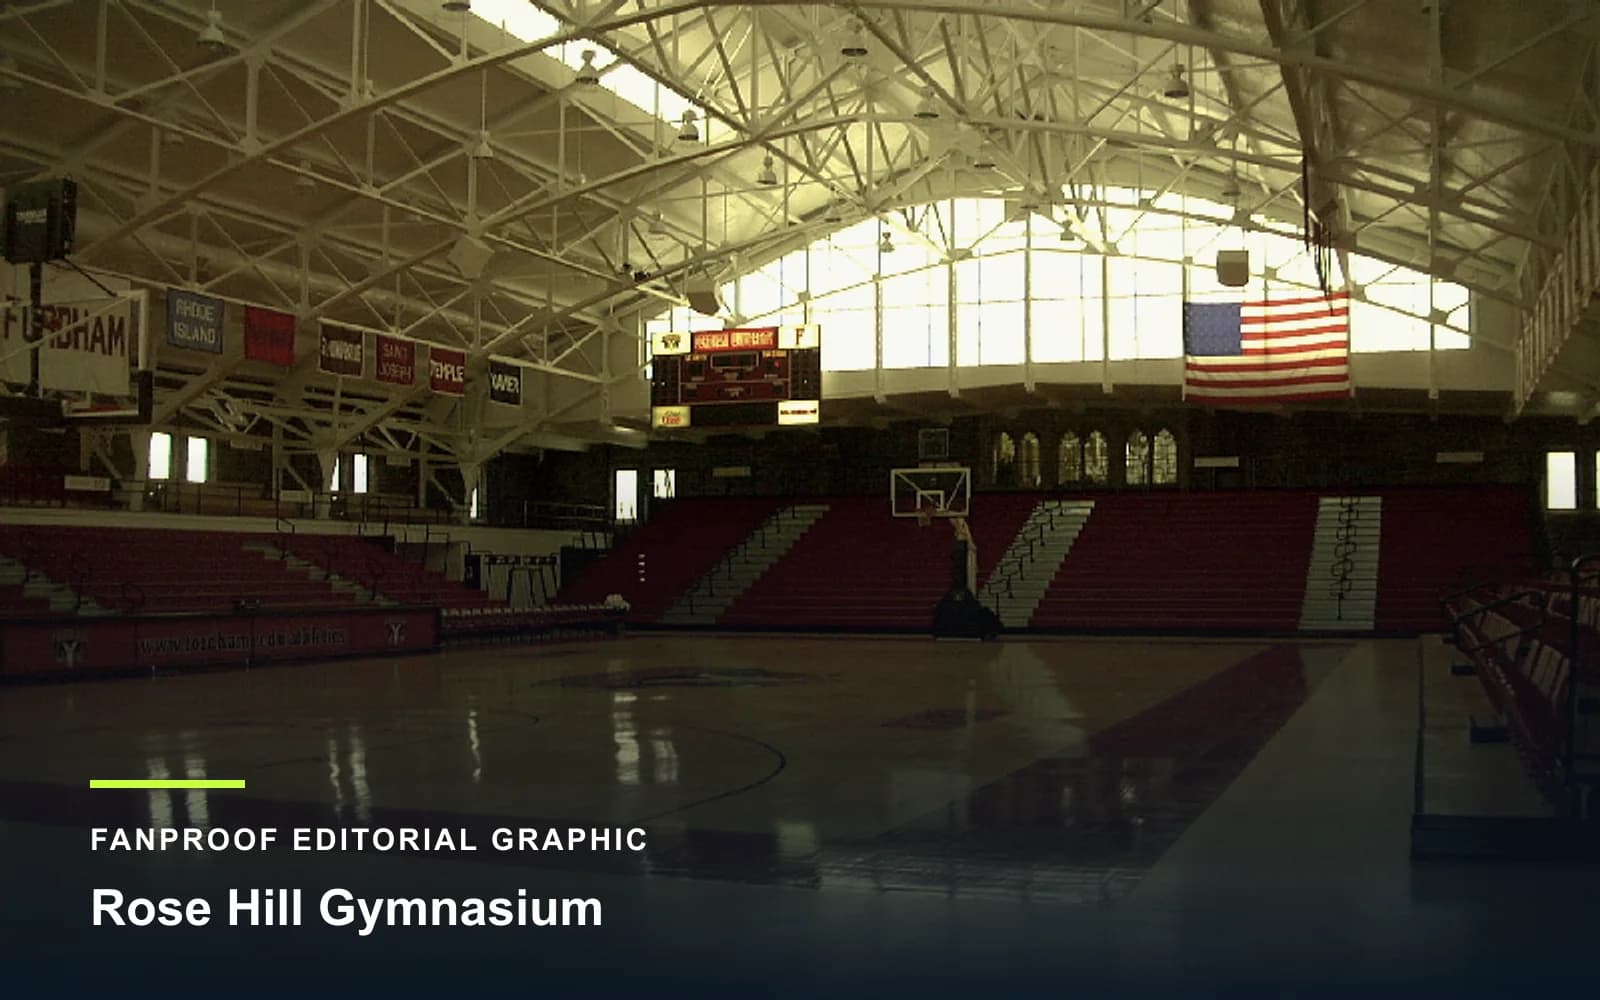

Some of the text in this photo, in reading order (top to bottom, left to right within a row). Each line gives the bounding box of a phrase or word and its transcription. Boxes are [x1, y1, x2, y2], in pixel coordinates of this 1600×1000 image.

[175, 298, 215, 321] RHODE
[173, 320, 216, 345] ISLAND
[430, 359, 465, 383] TEMPLE
